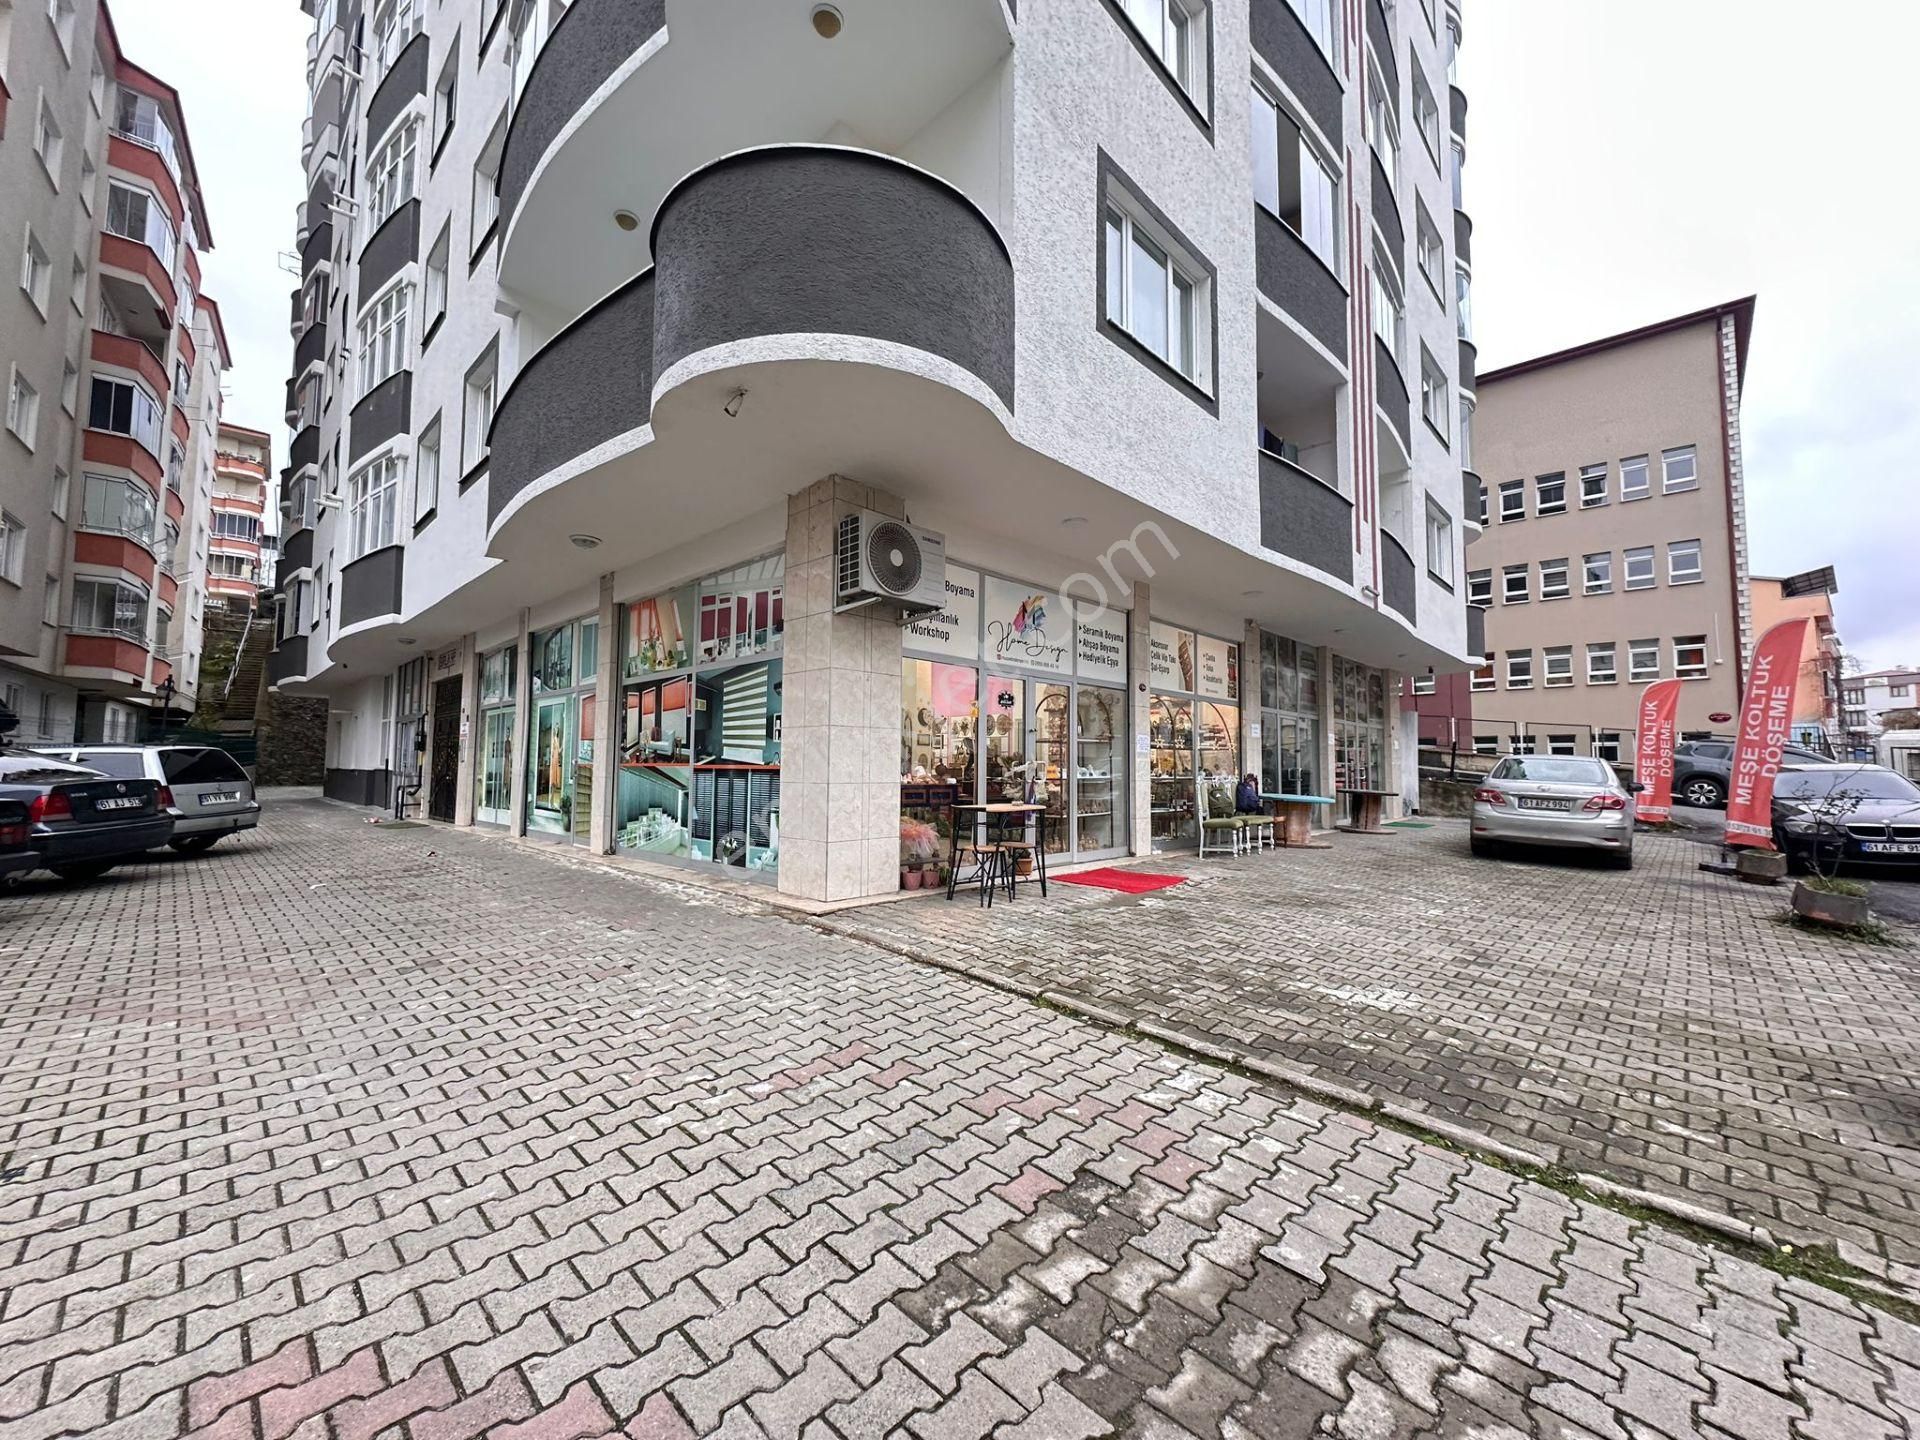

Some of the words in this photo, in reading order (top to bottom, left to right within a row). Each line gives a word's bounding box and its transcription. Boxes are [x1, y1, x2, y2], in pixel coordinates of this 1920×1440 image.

[945, 580, 975, 598] Boyama
[910, 622, 950, 642] Workshop
[988, 620, 1030, 652] Home
[1099, 641, 1119, 654] Boyama
[1104, 630, 1124, 643] Boyama
[1745, 654, 1774, 740] KOLTUK
[1642, 700, 1659, 754] KOLTUK
[1760, 685, 1790, 778] DÖŞEME
[1657, 719, 1672, 777] DÖŞEME
[1641, 759, 1659, 795] MEŞE
[1735, 746, 1760, 805] MEŞE
[1523, 798, 1533, 806] 61
[1867, 843, 1878, 851] 61
[1881, 844, 1904, 852] AFE
